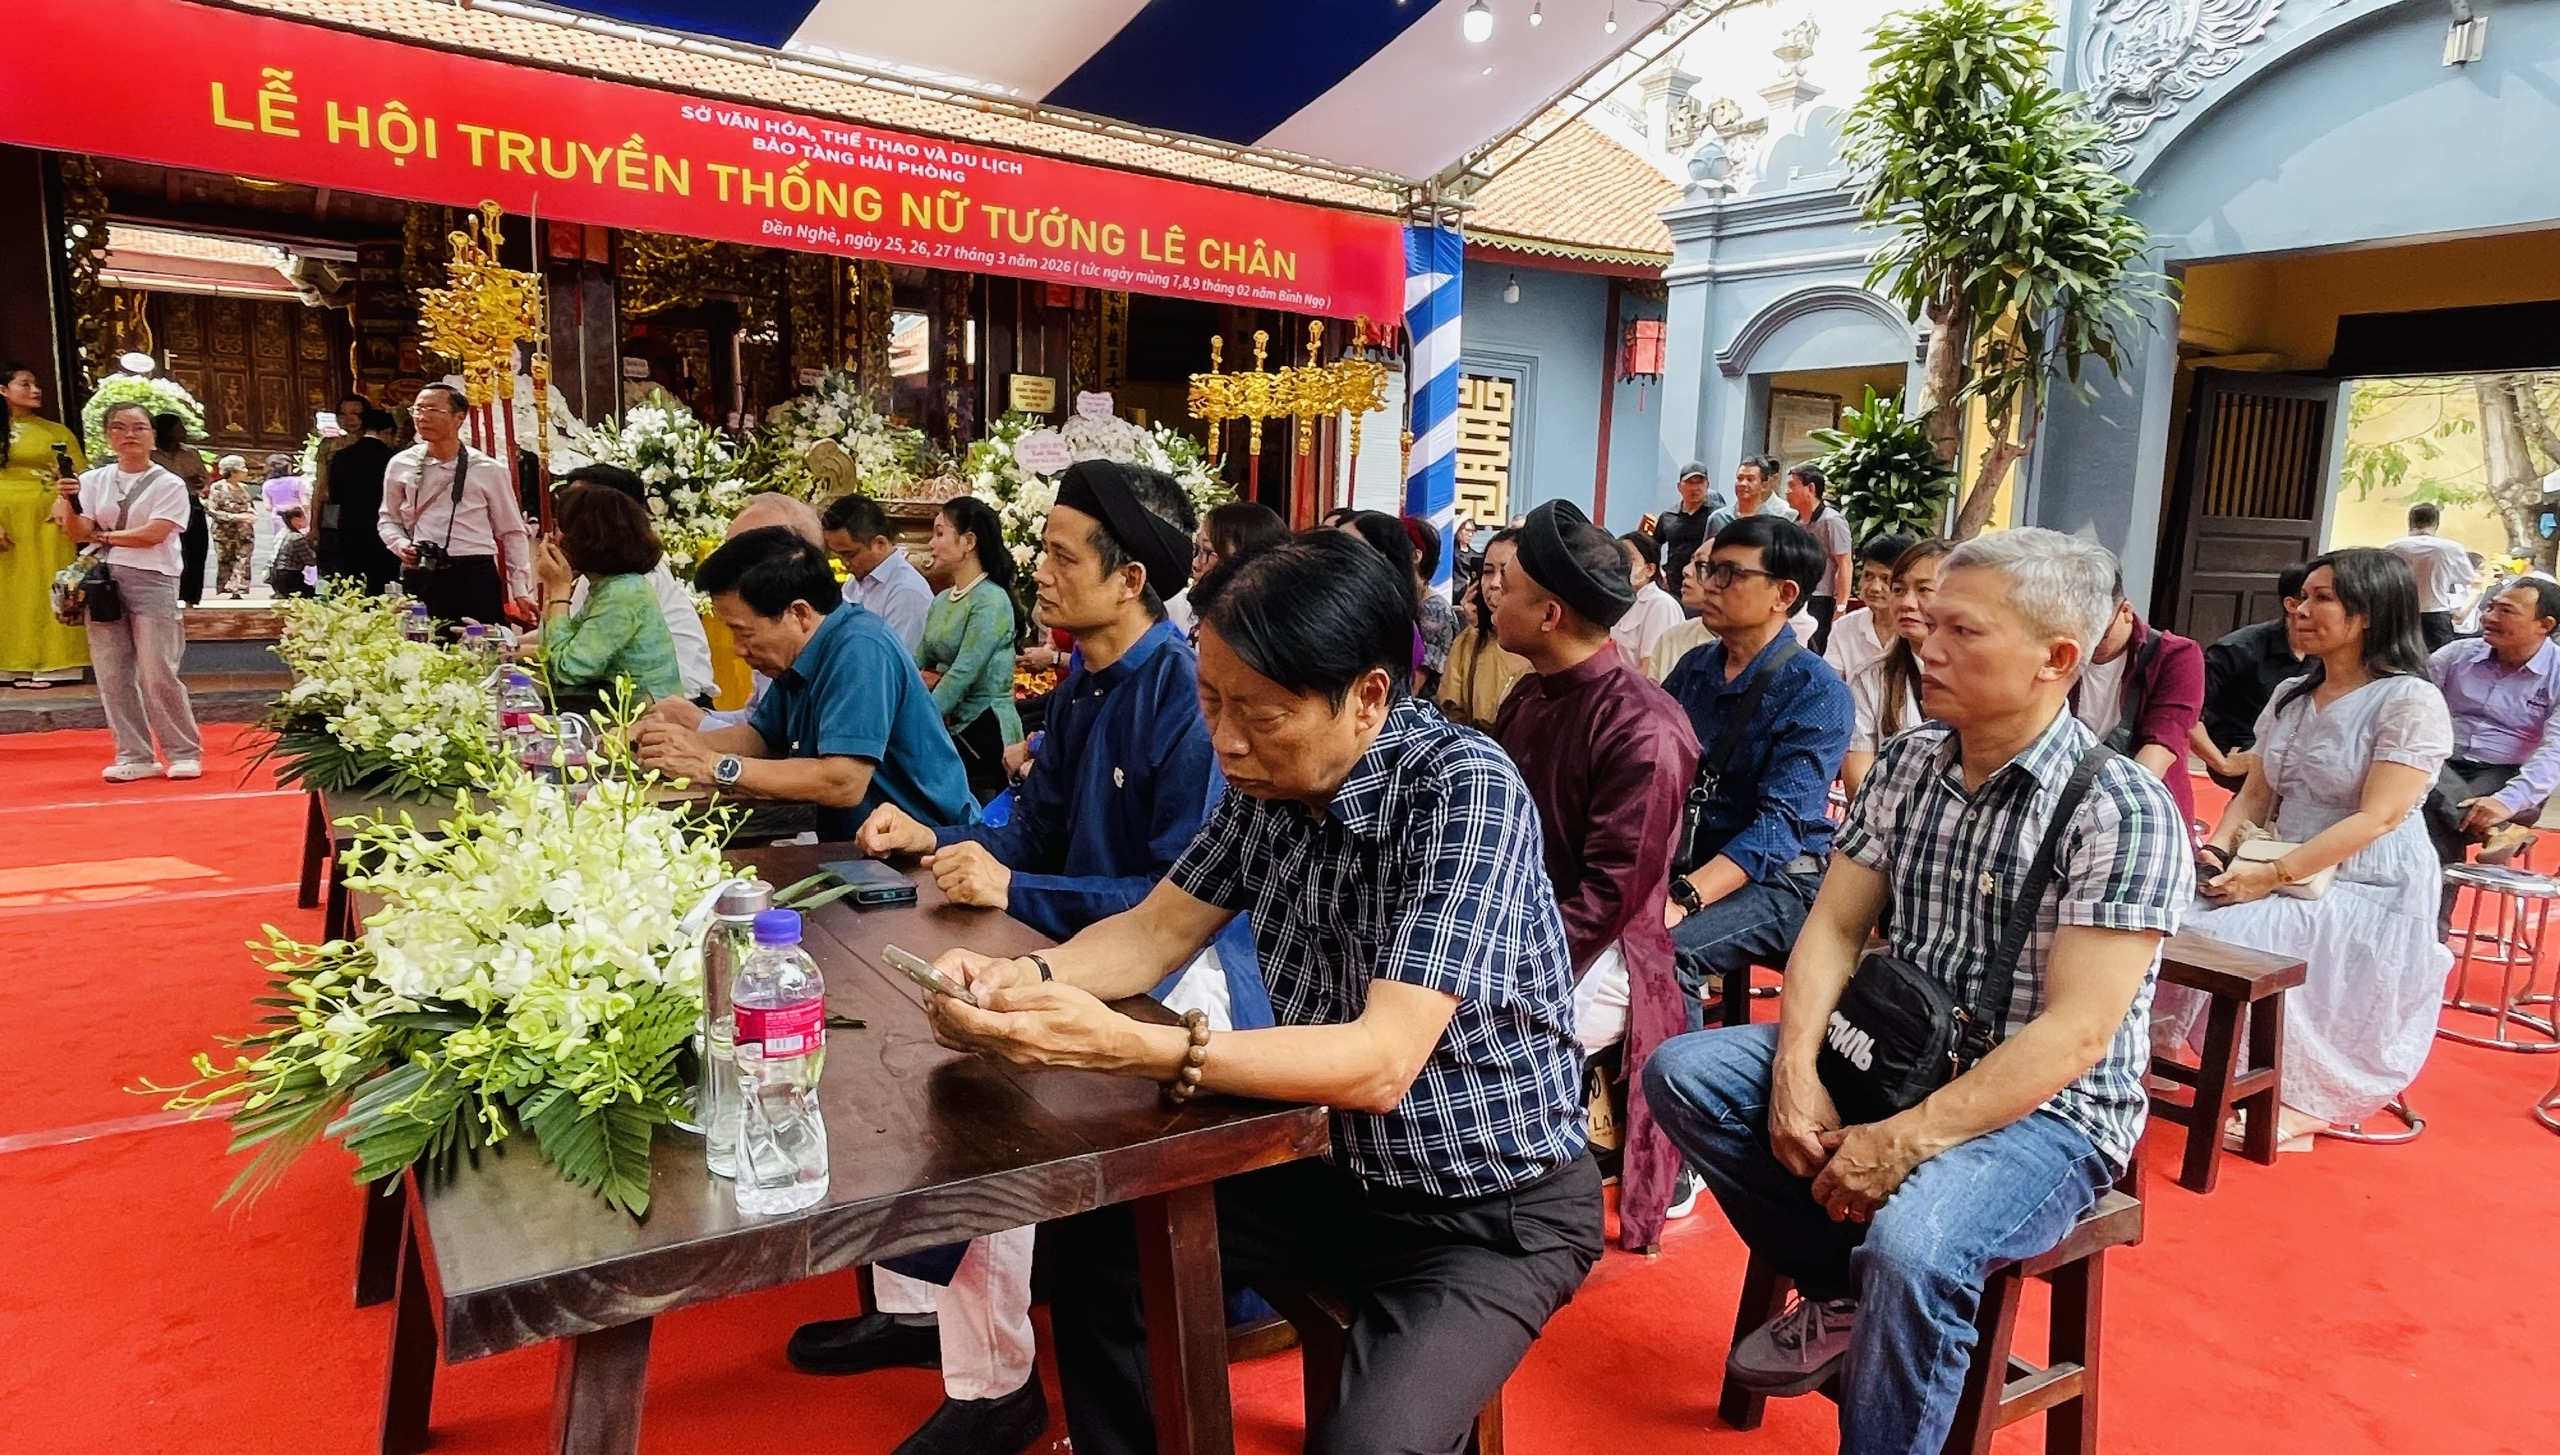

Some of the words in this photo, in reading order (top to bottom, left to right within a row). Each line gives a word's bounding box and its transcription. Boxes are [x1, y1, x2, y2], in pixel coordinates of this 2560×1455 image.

[211, 67, 300, 137] LỄ
[327, 100, 437, 166] HỘI
[457, 123, 690, 196] TRUYỀN
[707, 159, 883, 222] THỐNG
[902, 189, 971, 233] NỮ
[981, 205, 1126, 256] TƯỚNG
[1141, 224, 1186, 264] LÊ
[1199, 238, 1296, 281] CHÂN
[681, 105, 712, 122] SỞ
[716, 111, 759, 131] VĂN
[765, 120, 816, 142] HÓA,
[866, 137, 920, 157] THAO
[923, 146, 948, 162] VÀ
[951, 152, 977, 167] DU
[981, 157, 1023, 175] LỊCH
[753, 136, 796, 155] BẢO
[801, 144, 855, 165] TÀNG
[860, 152, 893, 171] HẢI
[898, 161, 966, 183] PHÒNG
[762, 219, 793, 236] Đền
[797, 224, 841, 246] Nghè,
[845, 231, 882, 251] ngày
[884, 236, 906, 254] 25,
[909, 240, 931, 258] 26,
[933, 243, 951, 258] 27
[954, 246, 994, 266] tháng
[997, 251, 1006, 264] 3
[1008, 253, 1038, 268] năm
[1040, 257, 1071, 273] 2026
[1103, 266, 1134, 285] ngày
[1202, 279, 1235, 297] tháng
[1237, 285, 1250, 297] 02
[1252, 286, 1276, 301] năm
